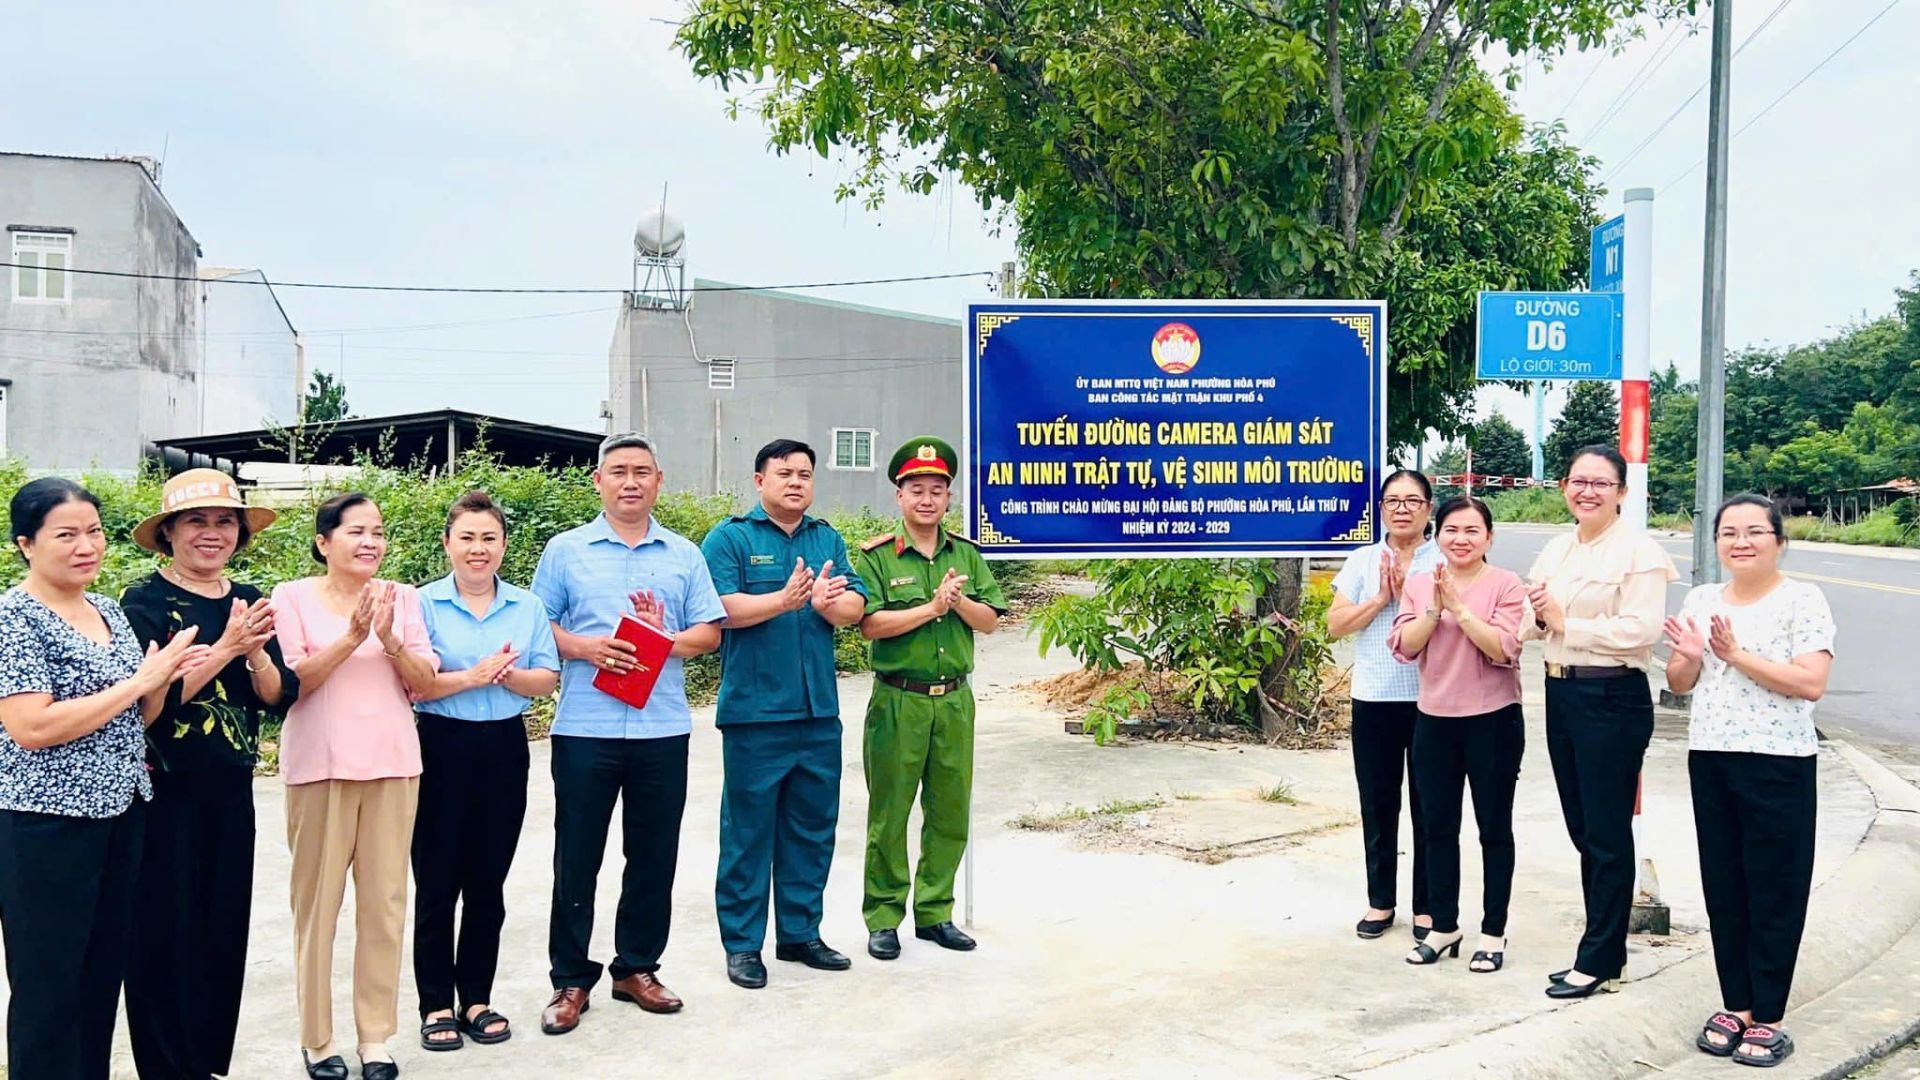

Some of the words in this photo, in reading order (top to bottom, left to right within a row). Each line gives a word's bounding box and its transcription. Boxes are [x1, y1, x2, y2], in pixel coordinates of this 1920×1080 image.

[1605, 244, 1619, 276] N1
[1515, 296, 1580, 316] ĐƯỜNG
[1527, 320, 1566, 351] D6
[1500, 357, 1520, 374] LỘ
[1523, 357, 1558, 372] GIỚI:
[1559, 359, 1592, 372] 30m
[1076, 376, 1089, 389] ỦY
[1091, 379, 1112, 388] BAN
[1115, 379, 1140, 389] MTTQ
[1143, 377, 1164, 390] VIỆT
[1166, 379, 1189, 388] NAM
[1192, 377, 1231, 388] PHƯỜNG
[1234, 377, 1254, 388] HÒA
[1256, 376, 1276, 388] PHÚ
[1088, 393, 1109, 403] BAN
[1111, 392, 1138, 403] CÔNG
[1140, 392, 1159, 403] TÁC
[1185, 392, 1211, 404] TRẬN
[1213, 393, 1233, 402] KHU
[1235, 390, 1256, 403] PHỐ
[1257, 393, 1264, 402] 4
[1017, 414, 1078, 445] TUYẾN
[1084, 417, 1151, 445] ĐƯỜNG
[1157, 422, 1238, 445] CAMERA
[1243, 416, 1292, 444] GIÁM
[1298, 416, 1334, 444] SÁT
[987, 462, 1014, 485] AN
[1020, 462, 1067, 485] NINH
[1072, 456, 1121, 489] TRẬT
[1126, 459, 1157, 489] TỰ,
[1162, 456, 1187, 489] VỆ
[1192, 461, 1238, 484] SINH
[1244, 456, 1281, 484] MÔI
[1286, 455, 1364, 484] TRƯỜNG
[1001, 499, 1028, 514] CÔNG
[1030, 498, 1059, 514] TRÌNH
[1062, 498, 1089, 514] CHÀO
[1091, 498, 1120, 514] MỪNG
[1123, 500, 1140, 516] ĐẠI
[1142, 498, 1159, 516] HỘI
[1162, 497, 1189, 513] ĐẢNG
[1191, 497, 1204, 515] BỘ
[1207, 497, 1247, 513] PHƯỜNG
[1249, 497, 1269, 512] HÒA
[1272, 496, 1295, 514] PHÚ,
[1318, 496, 1338, 512] THỨ
[1340, 500, 1350, 511] IV
[1122, 519, 1154, 537] NHIỆM
[1157, 519, 1169, 533] KỲ
[1171, 521, 1196, 534] 2024
[1205, 521, 1230, 534] 2029
